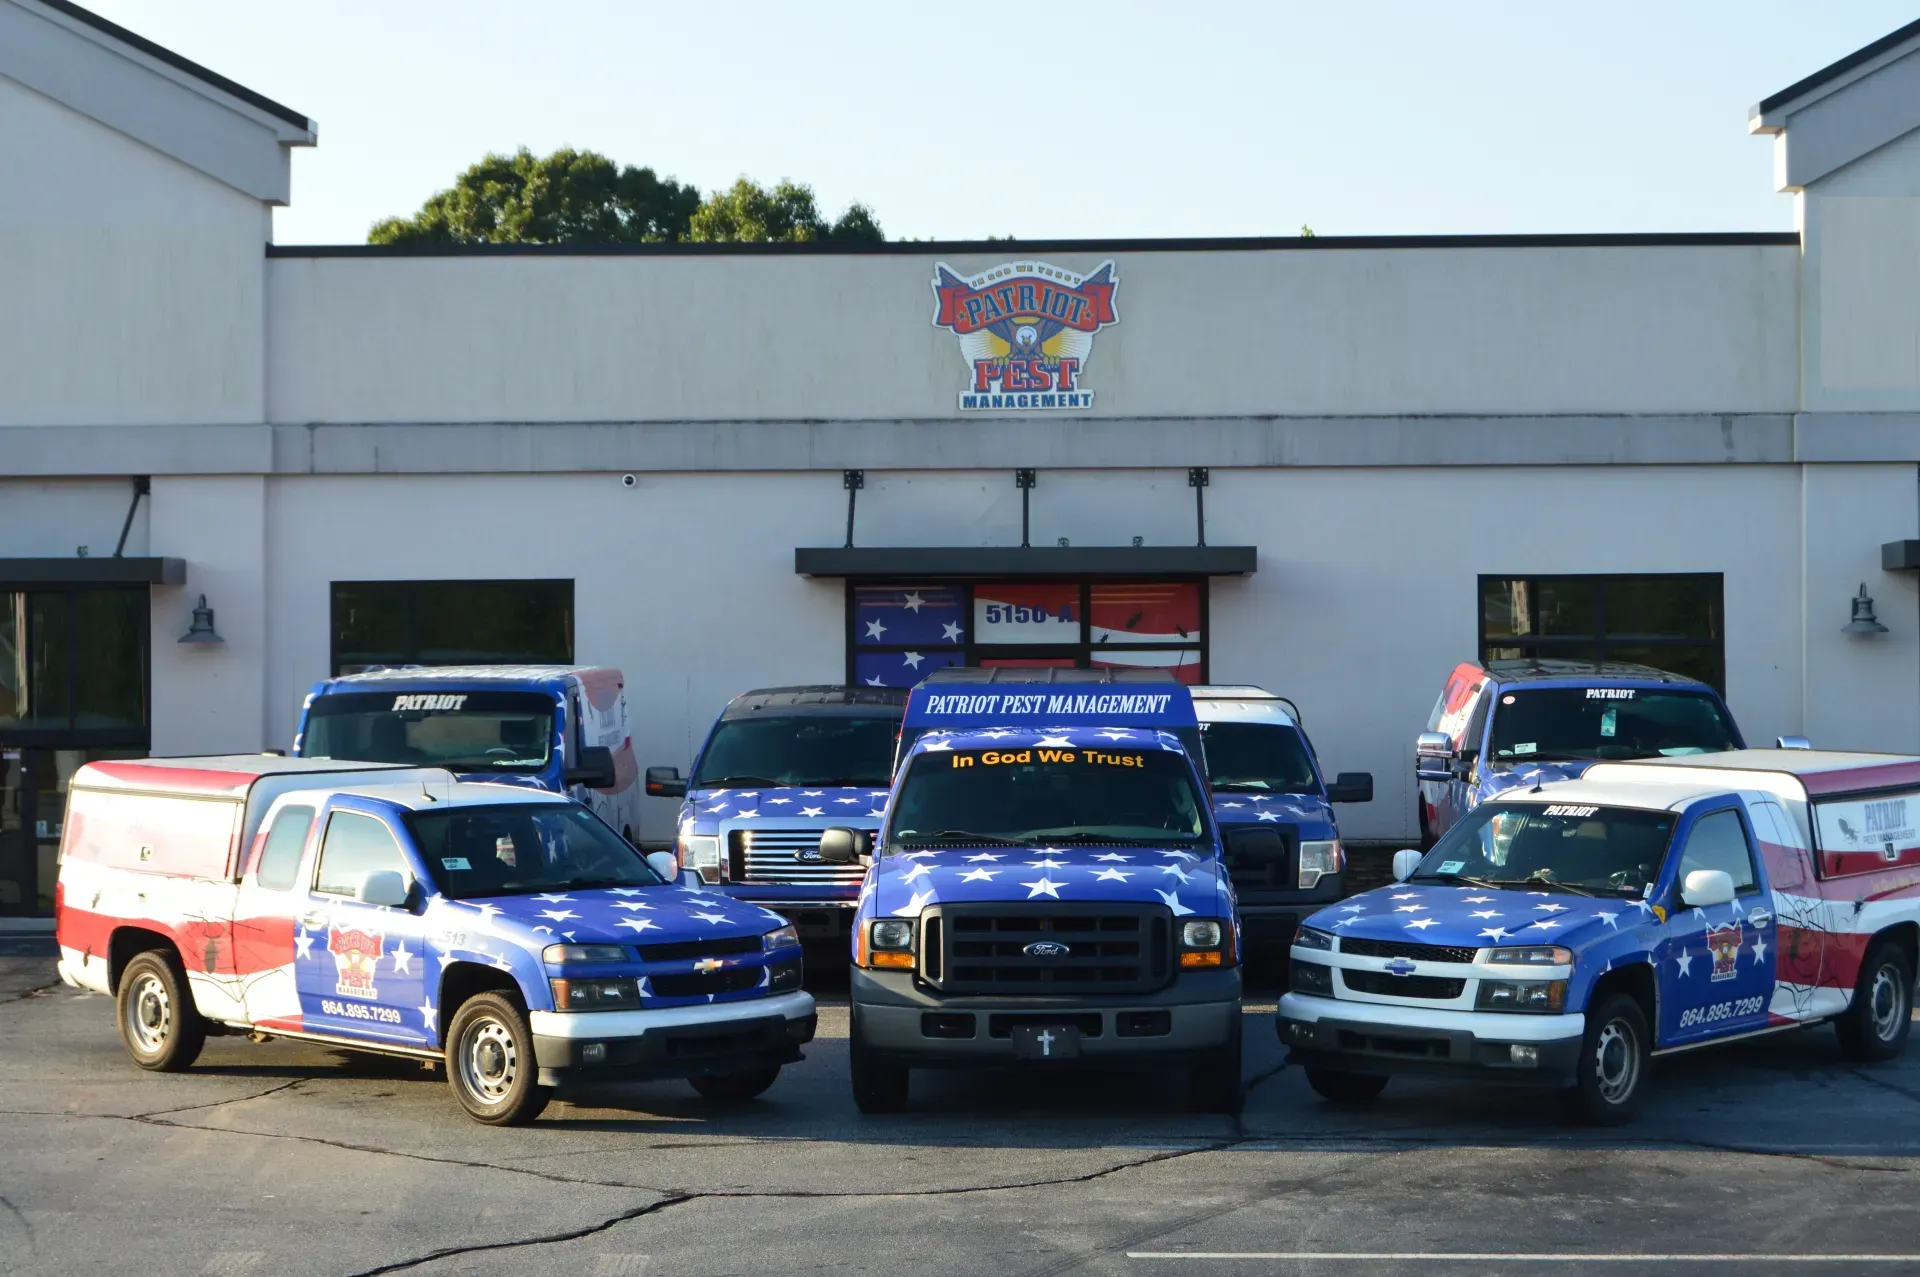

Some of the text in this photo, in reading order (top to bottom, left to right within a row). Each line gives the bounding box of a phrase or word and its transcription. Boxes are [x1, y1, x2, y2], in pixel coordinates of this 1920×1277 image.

[964, 284, 1088, 326] PATRIOT
[973, 357, 1080, 393] PEST
[963, 393, 1091, 408] MANAGEMENT
[986, 604, 1074, 623] 5150-A
[391, 695, 468, 711] PATRIOT
[1585, 689, 1636, 699] PATRIOT
[925, 695, 1171, 714] PATRIOT PEST MANAGEMENT
[952, 750, 1144, 768] In God We Trust
[1542, 805, 1599, 817] PATRIOT
[1863, 800, 1907, 832] PATRIOT
[1863, 829, 1916, 844] PEST MANAGEMENT
[1033, 944, 1059, 955] Ford
[321, 1000, 401, 1023] 864.895.7299
[1680, 996, 1764, 1028] 864.895.7299
